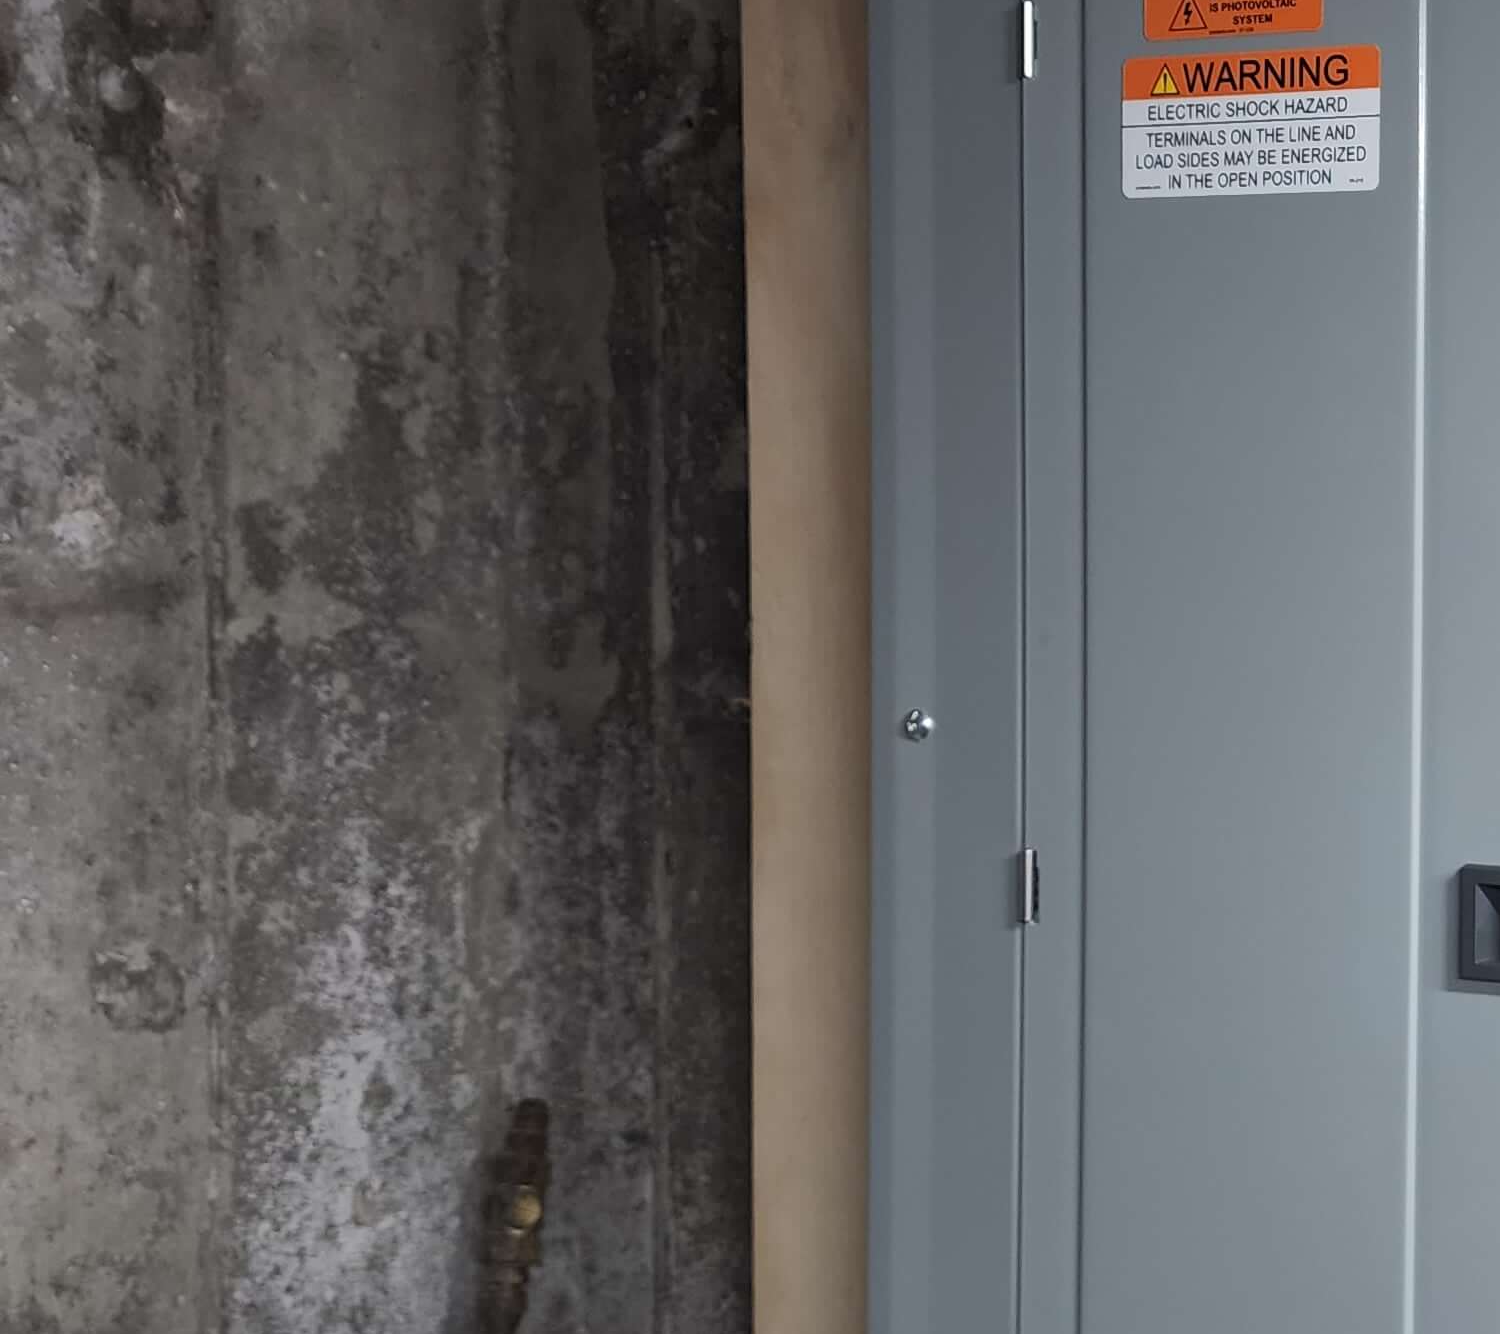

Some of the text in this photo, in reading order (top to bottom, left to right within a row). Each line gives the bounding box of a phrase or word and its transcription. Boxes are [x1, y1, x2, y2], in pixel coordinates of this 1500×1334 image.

[1209, 3, 1218, 12] IS
[1233, 14, 1272, 25] SYSTEM
[1183, 54, 1349, 93] WARNING
[1148, 97, 1347, 121] ELECTRIC SHOCK HAZARD
[1146, 124, 1356, 148] TERMINALS ON THE LINE AND
[1136, 146, 1366, 169] LOAD SIDES MAY BE ENERGIZED
[1168, 169, 1332, 189] IN THE OPEN POSITION
